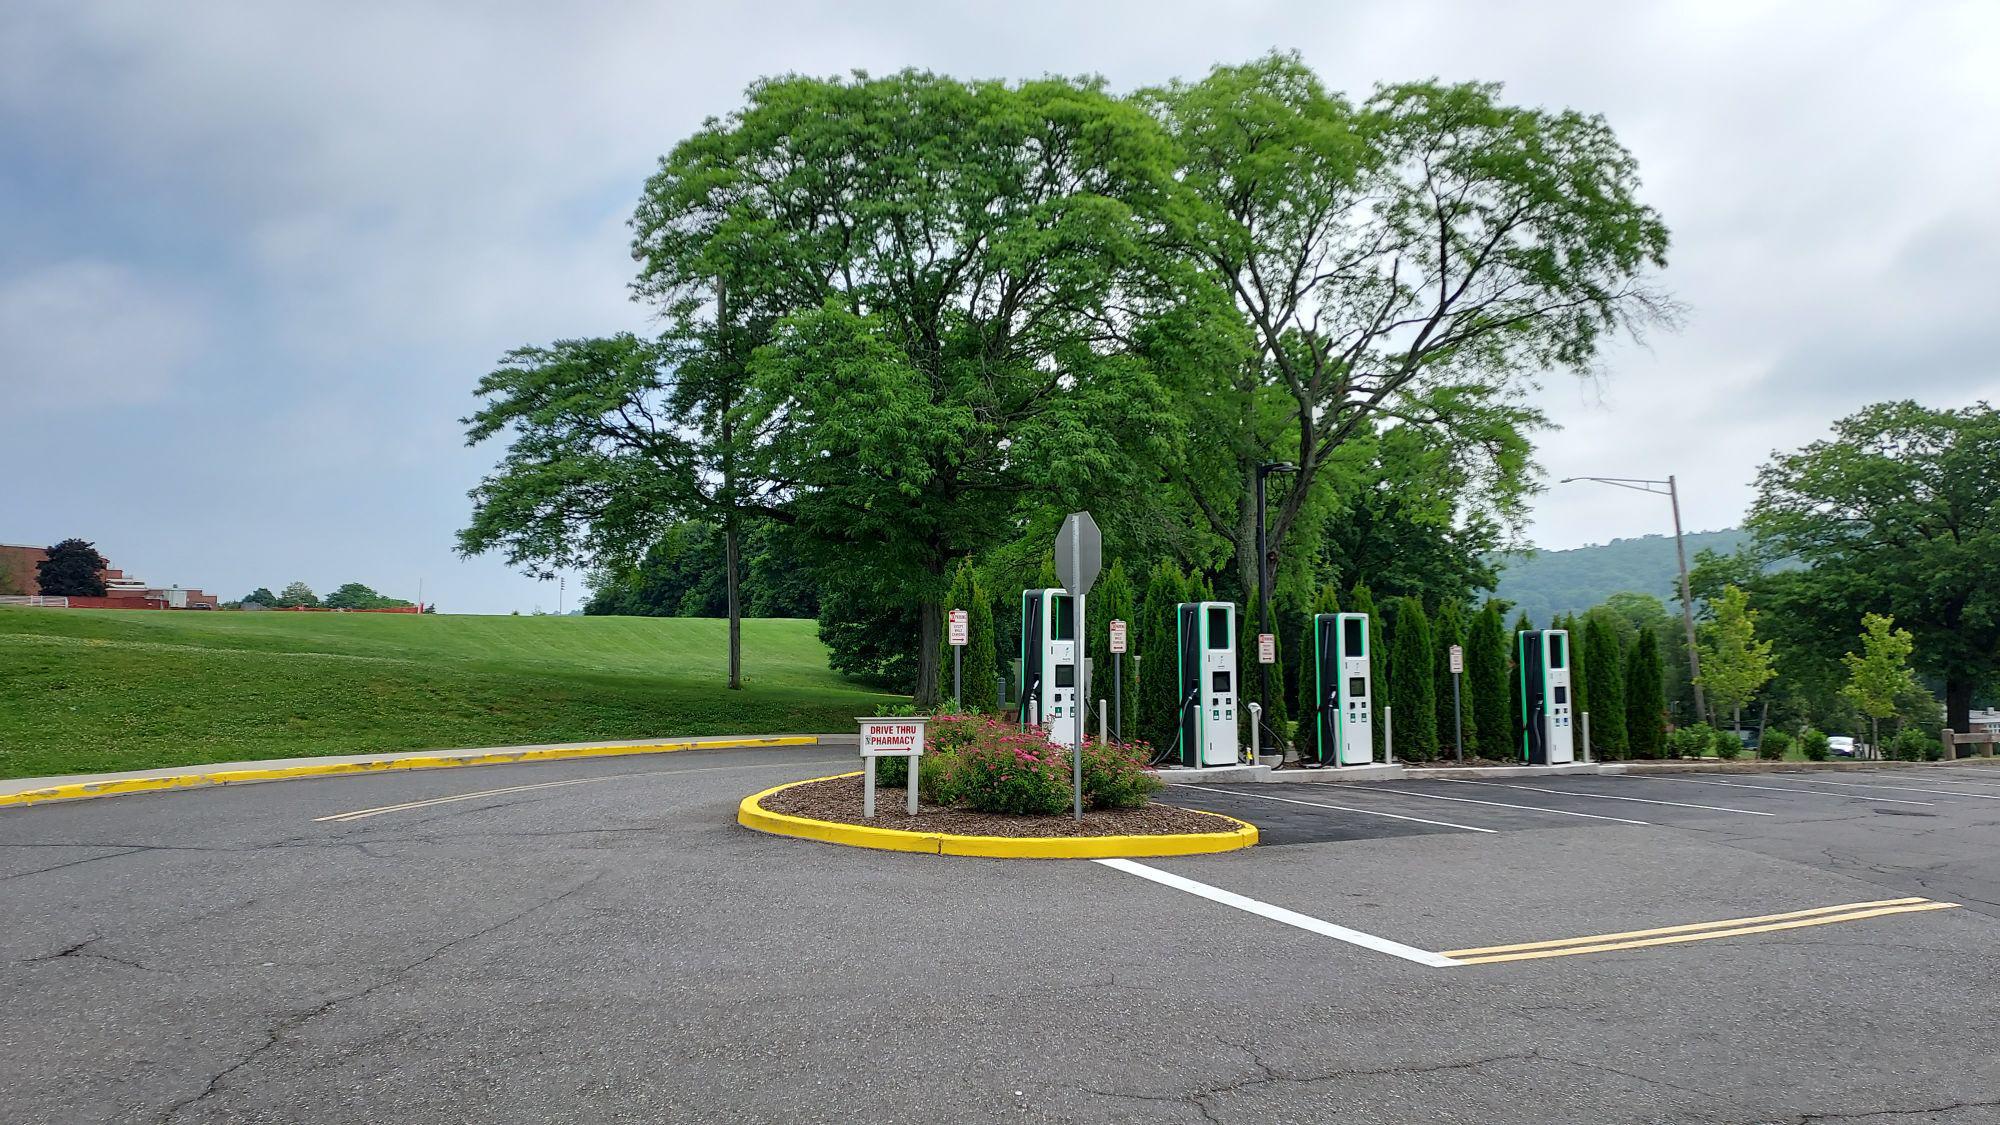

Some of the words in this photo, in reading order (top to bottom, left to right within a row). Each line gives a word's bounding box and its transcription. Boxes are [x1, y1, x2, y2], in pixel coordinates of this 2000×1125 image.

[870, 725, 894, 735] DRIVE
[896, 725, 917, 735] THRU
[871, 736, 915, 746] PHARMACY
